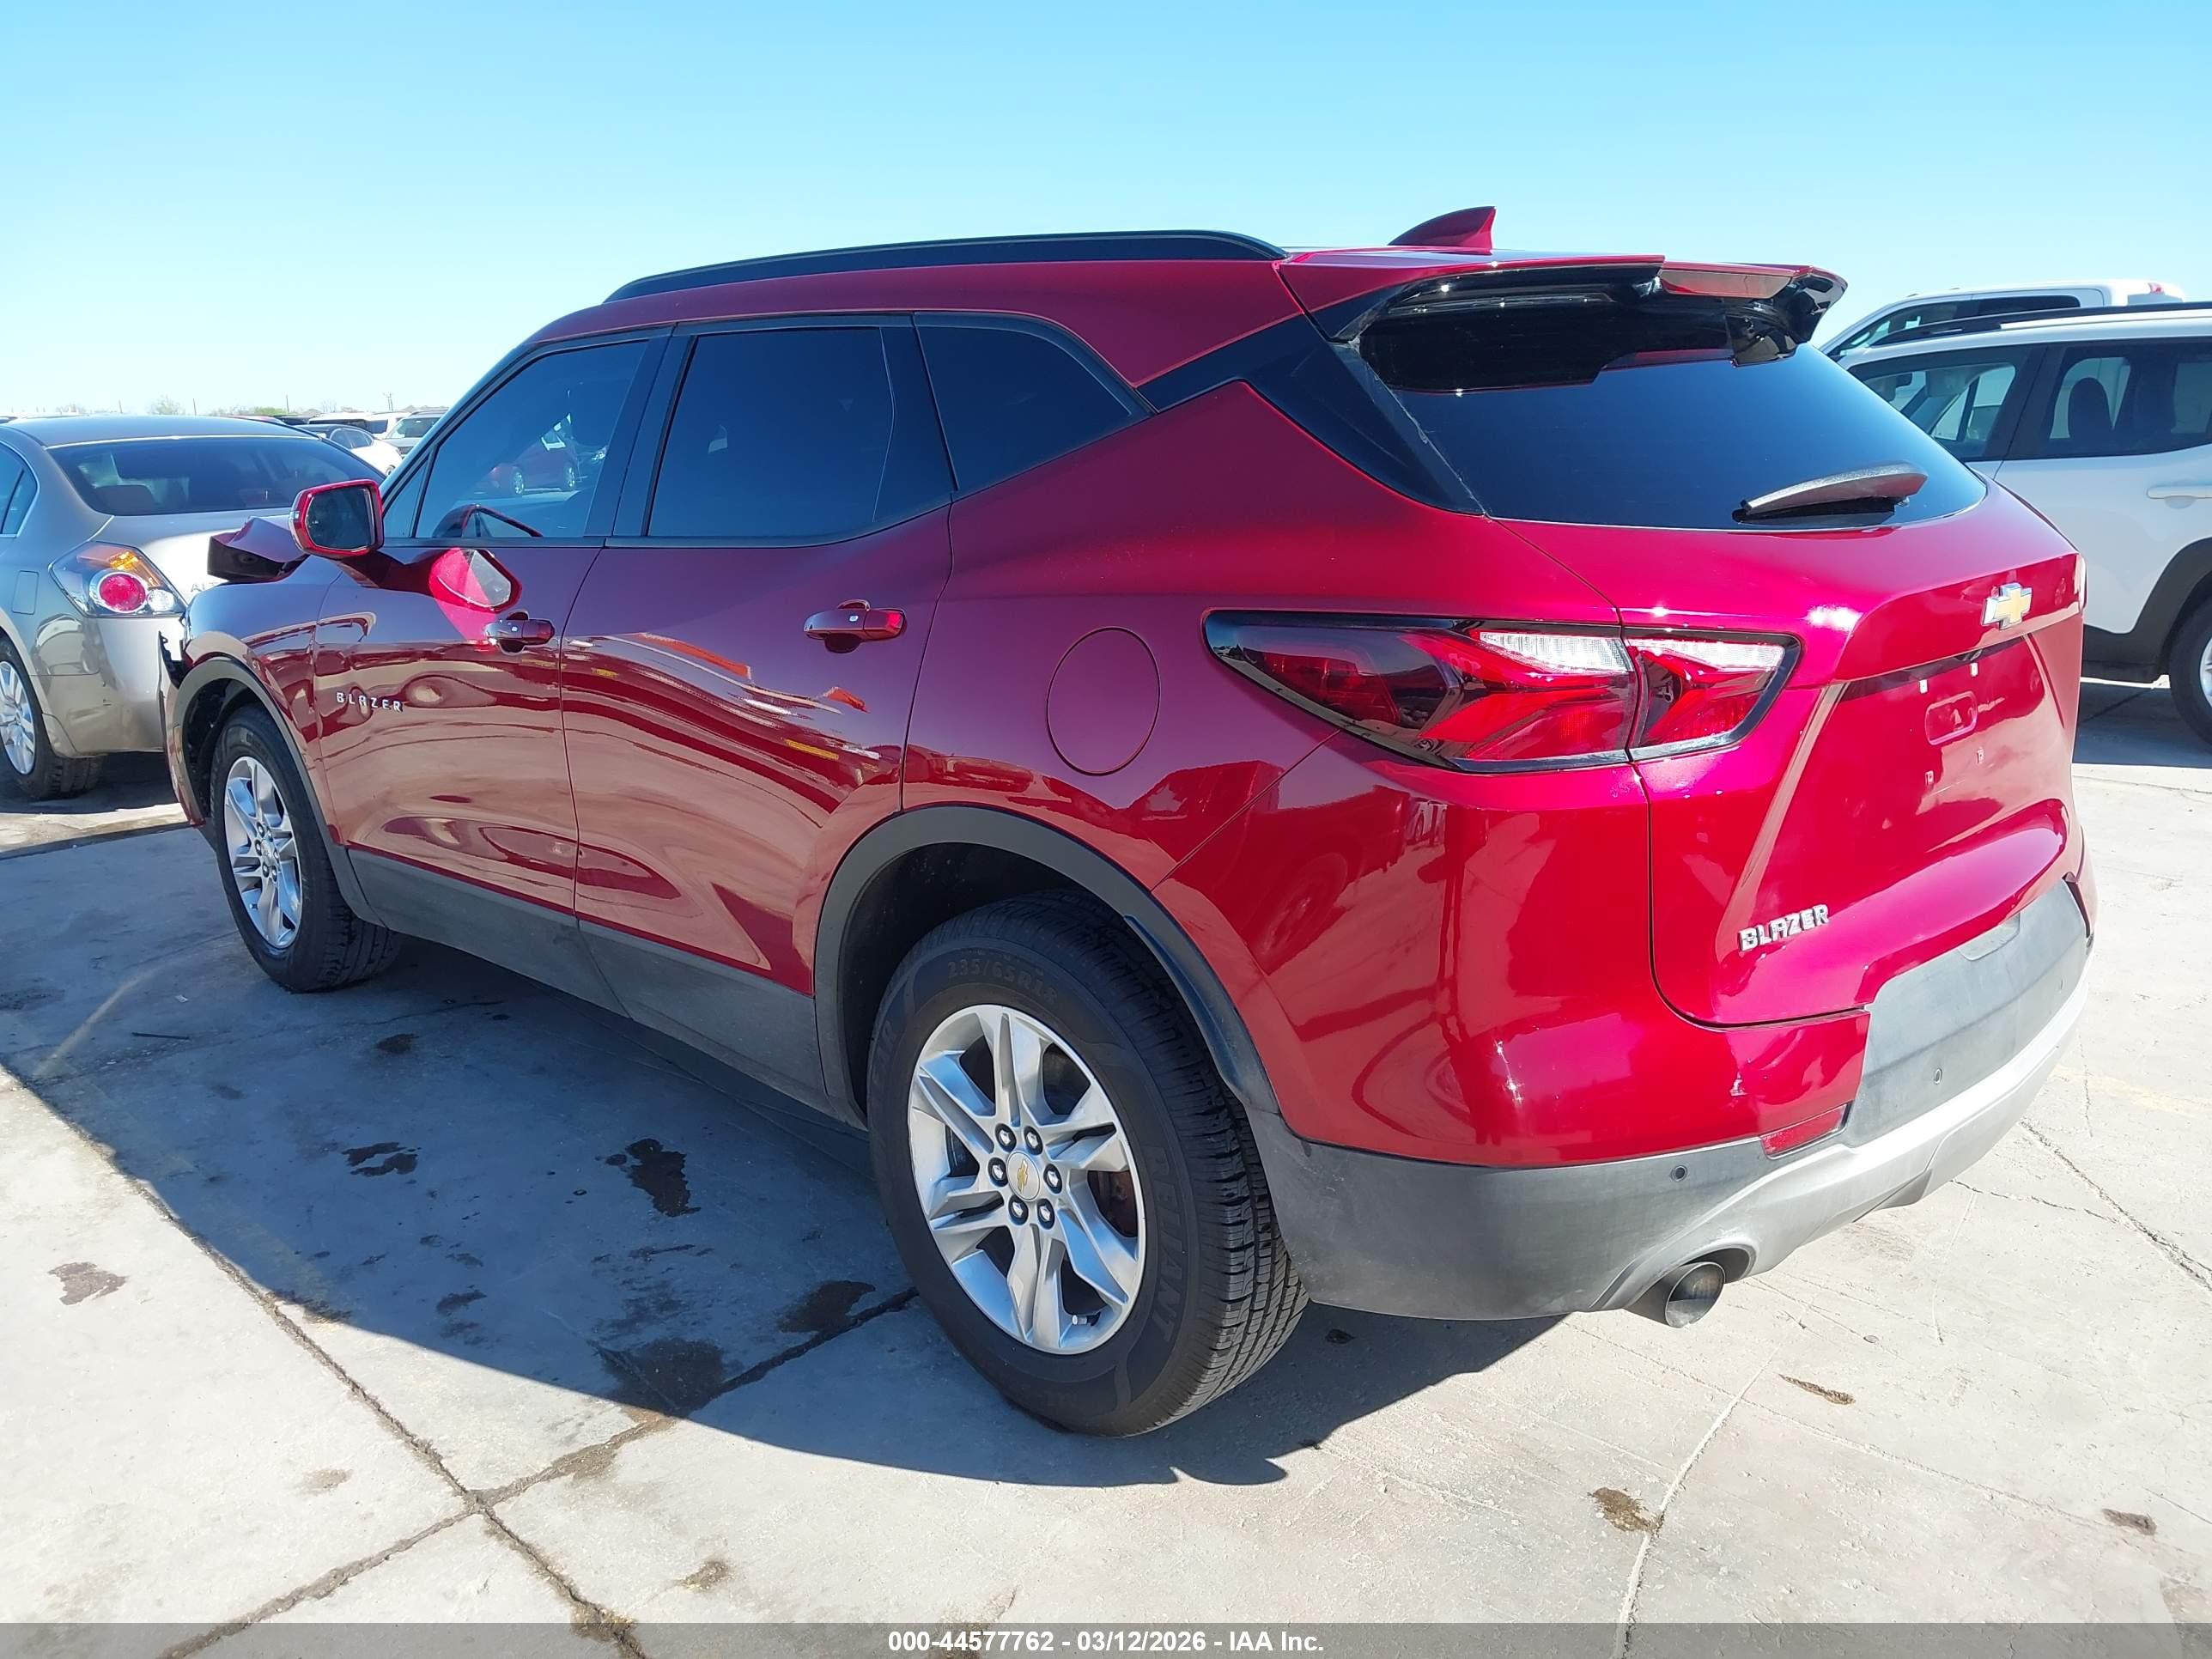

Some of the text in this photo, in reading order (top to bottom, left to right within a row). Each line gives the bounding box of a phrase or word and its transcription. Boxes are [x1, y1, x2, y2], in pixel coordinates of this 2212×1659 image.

[337, 692, 404, 713] BLAZER
[1737, 904, 1830, 951] BLAZER
[1144, 1144, 1182, 1343] RELIANT
